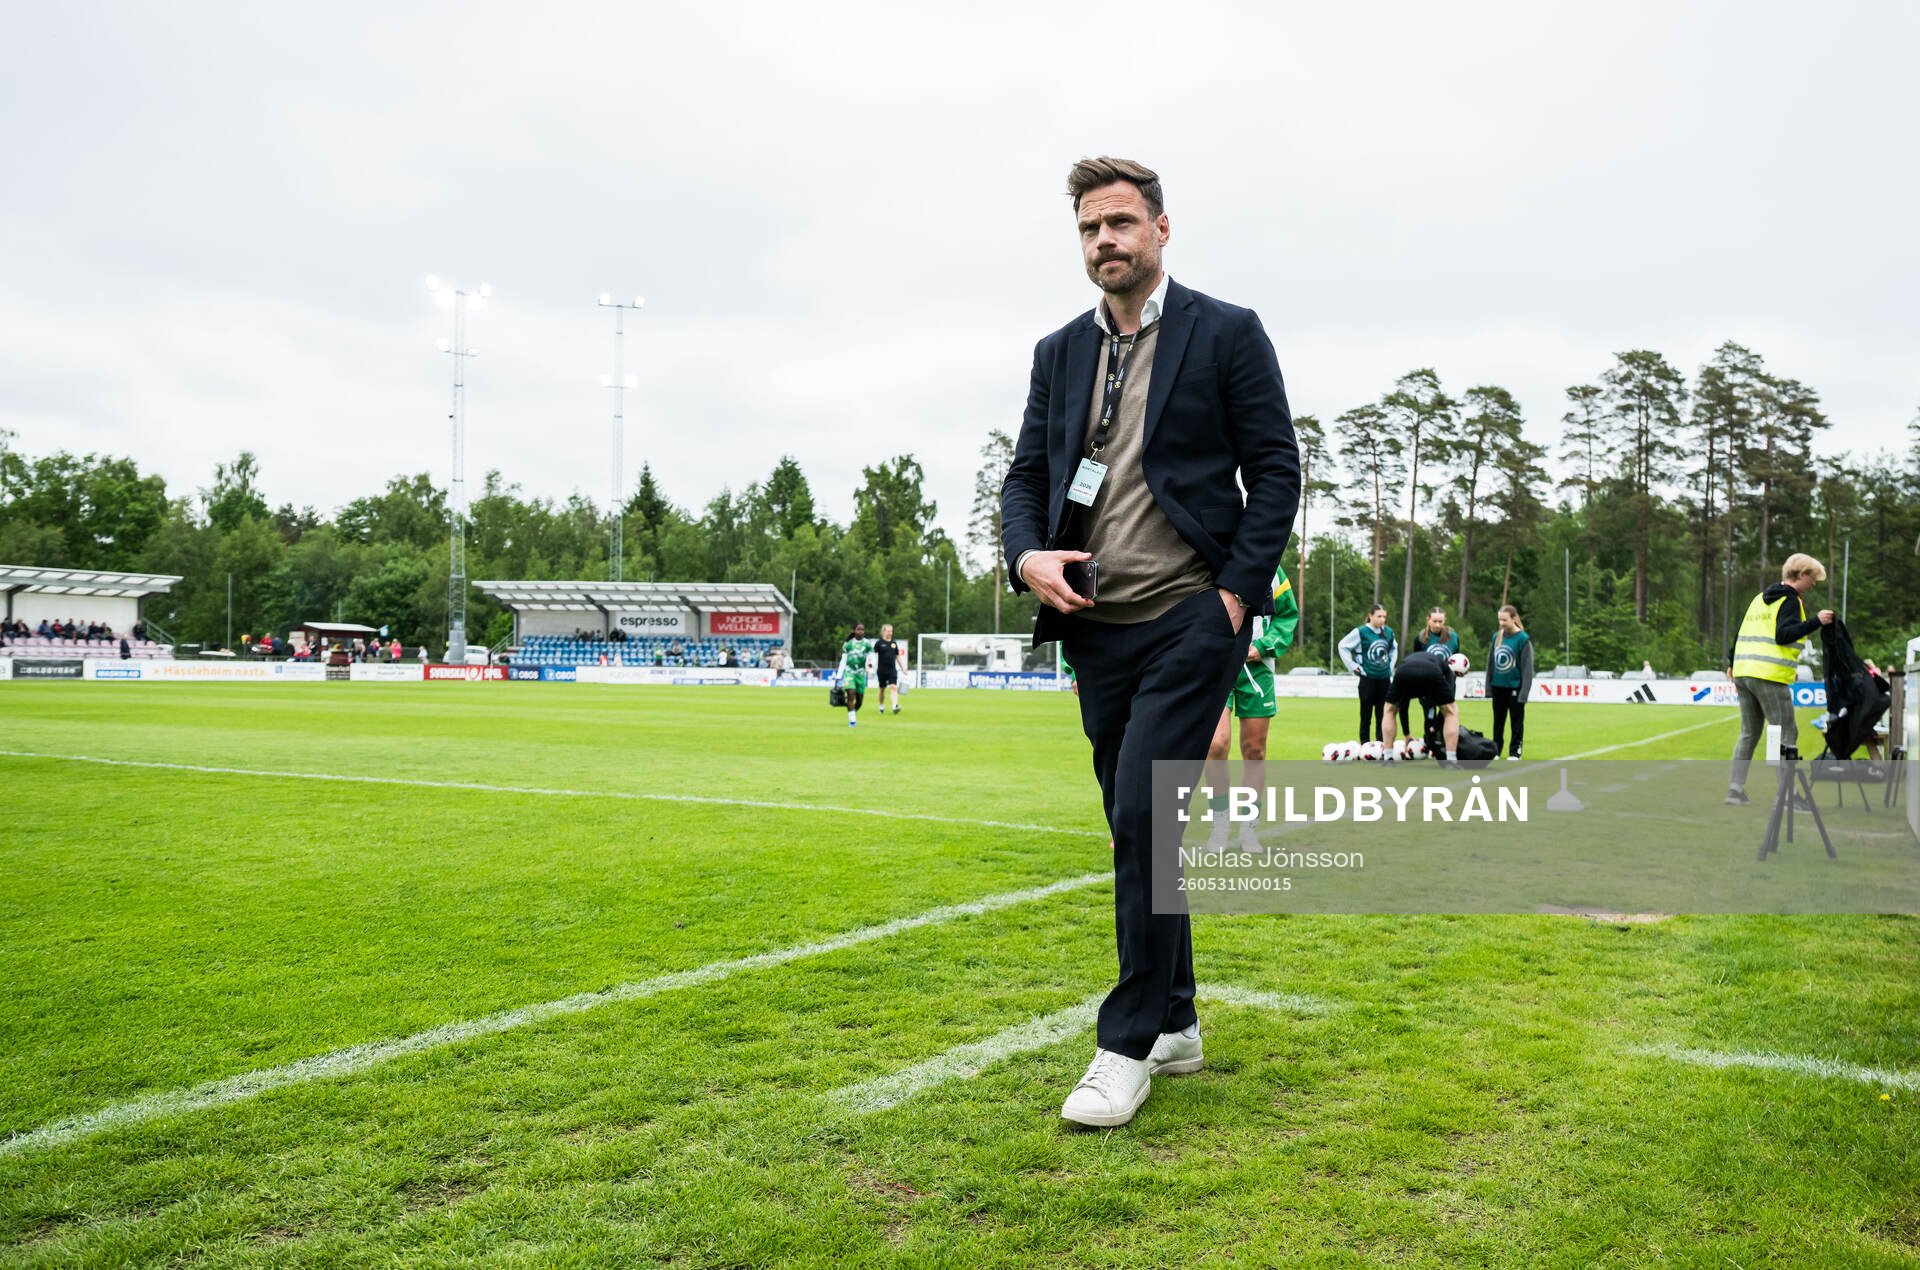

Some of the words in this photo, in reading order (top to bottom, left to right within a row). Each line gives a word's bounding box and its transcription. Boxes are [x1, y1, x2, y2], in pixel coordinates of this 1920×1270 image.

[620, 616, 679, 628] espresso
[725, 615, 763, 623] NORDIC
[717, 623, 773, 632] WELLNESS
[429, 667, 465, 678] SVENSKA
[484, 667, 503, 679] SPEL
[1540, 684, 1594, 696] NIBE
[1713, 685, 1739, 695] INT
